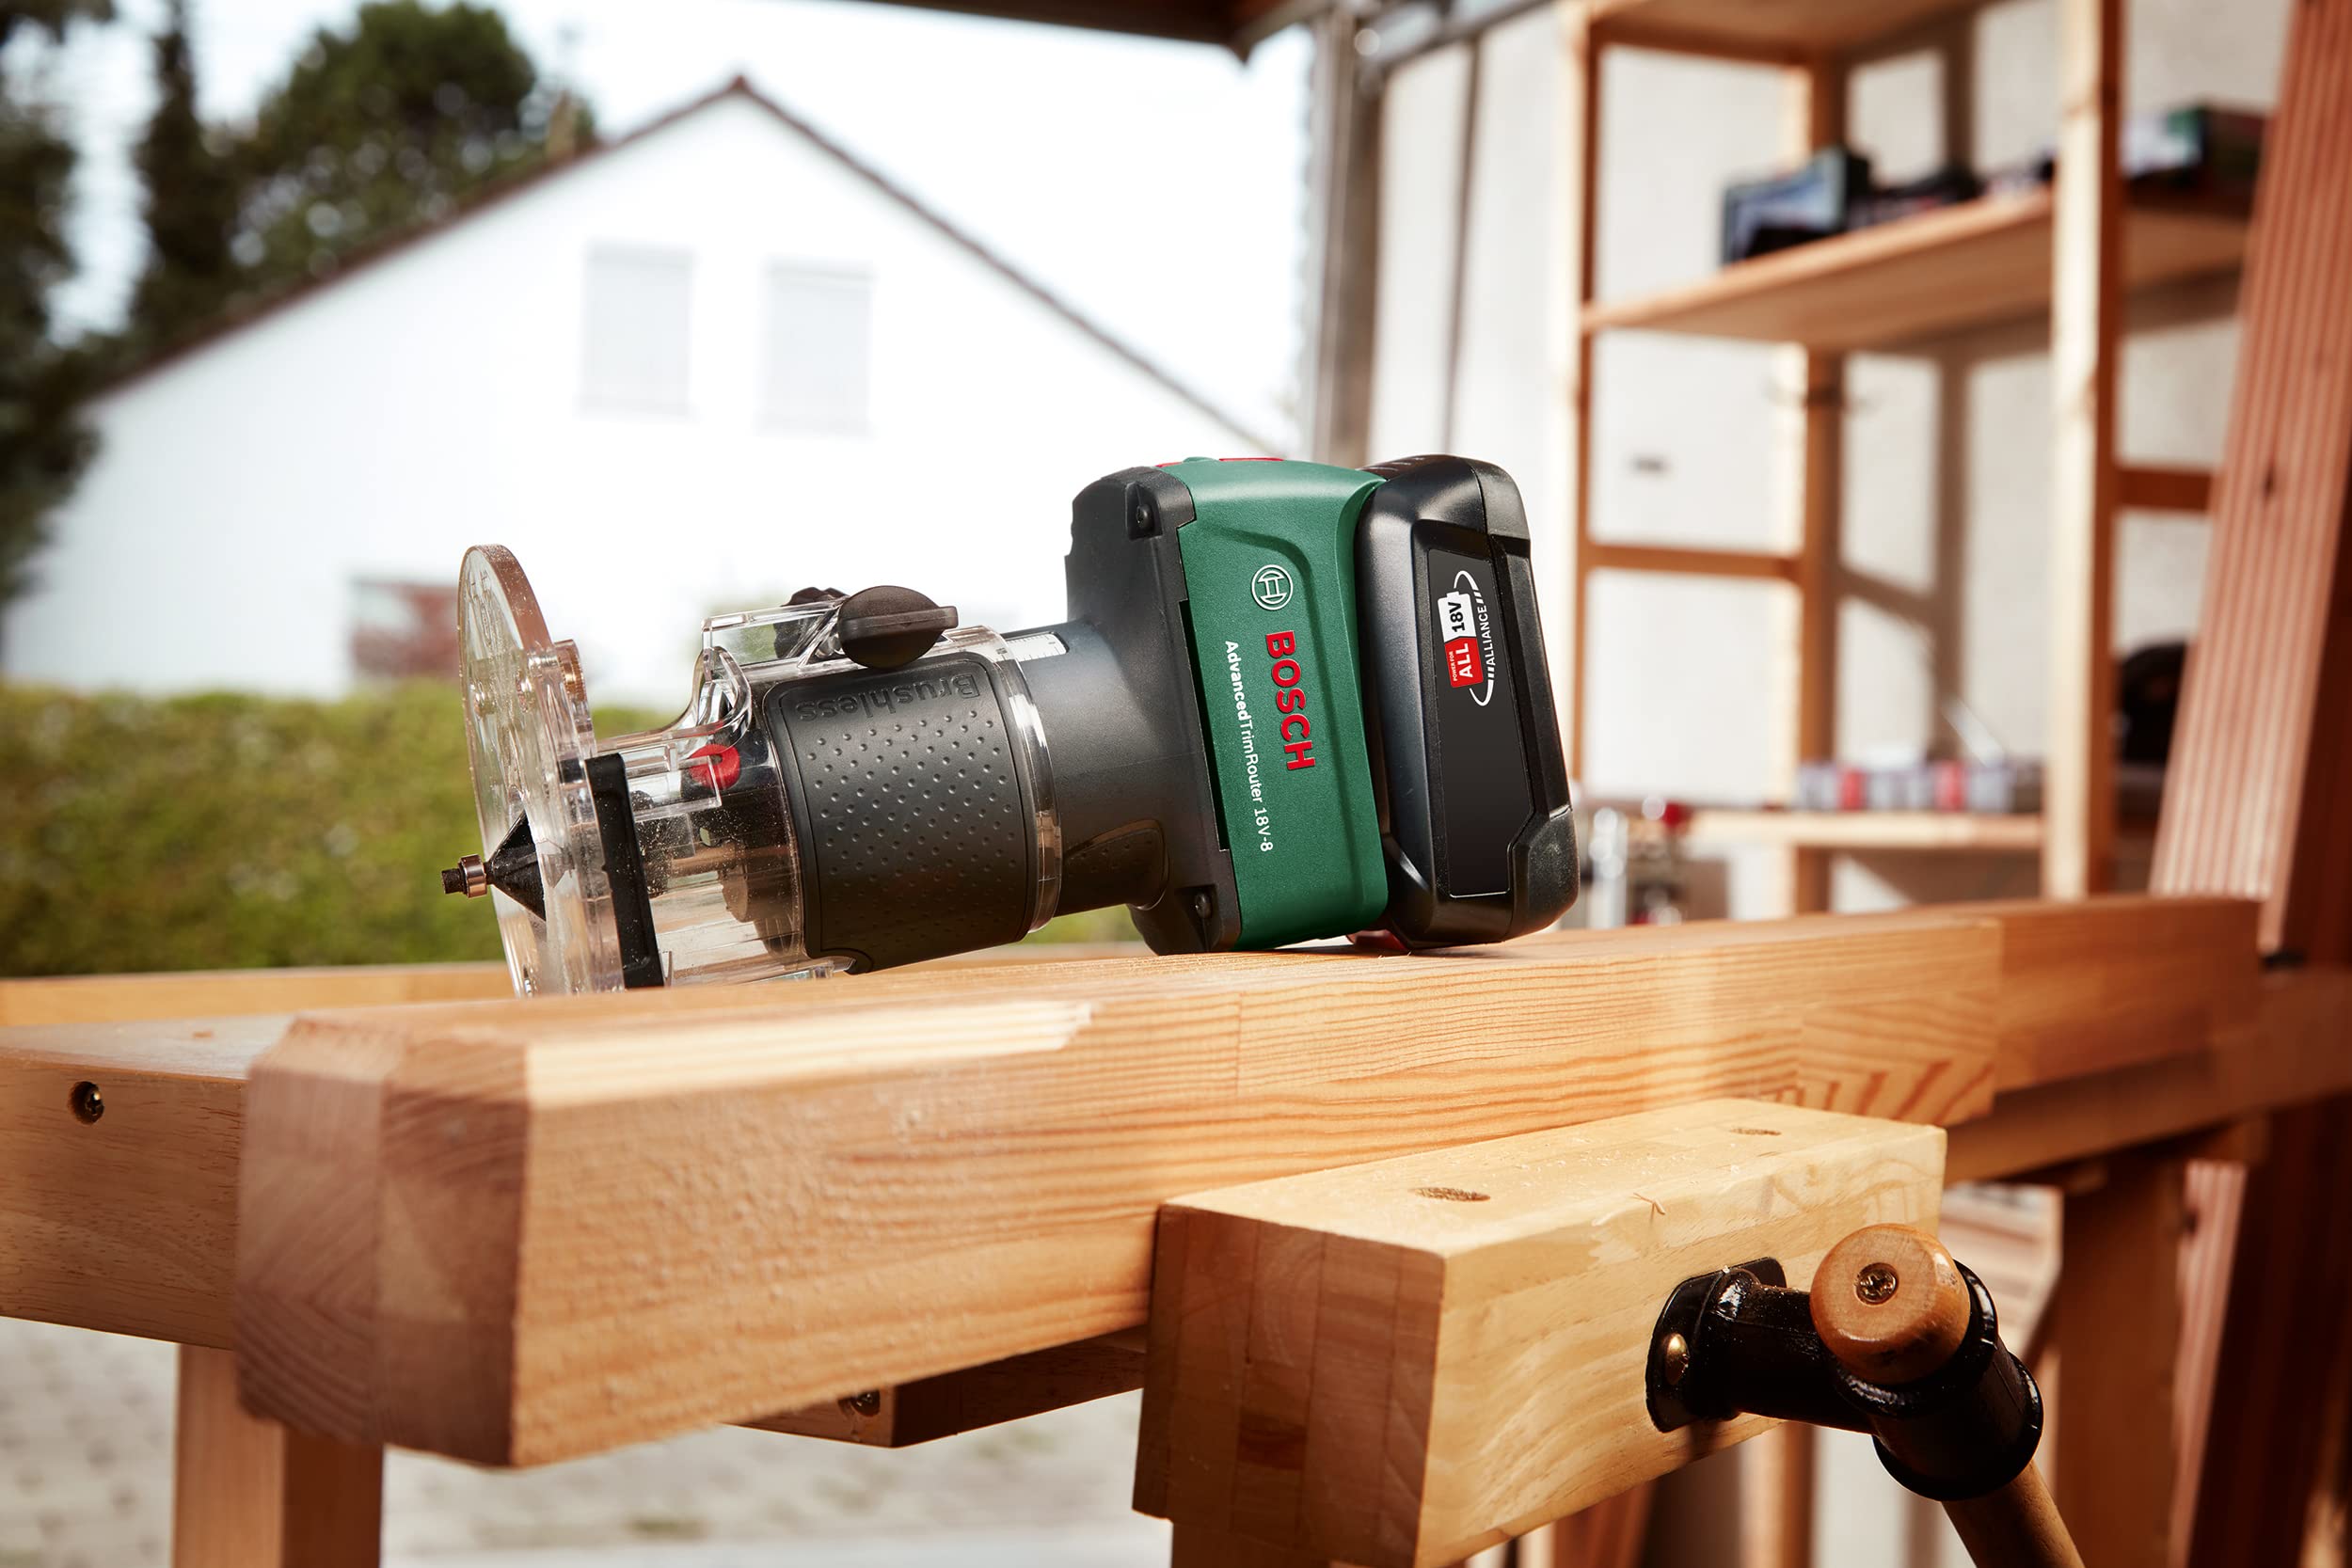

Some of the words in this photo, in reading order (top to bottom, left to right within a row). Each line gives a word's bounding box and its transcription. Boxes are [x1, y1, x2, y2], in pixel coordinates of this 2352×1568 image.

[1448, 601, 1465, 633] 18V
[1477, 605, 1496, 666] ALLIANCE
[1450, 662, 1458, 682] POWER
[1455, 642, 1473, 678] ALL
[795, 673, 980, 721] Brushless
[1265, 629, 1316, 771] BOSCH
[1225, 641, 1263, 804] AdvancedTrimRouter
[1254, 807, 1274, 852] 18V-8
